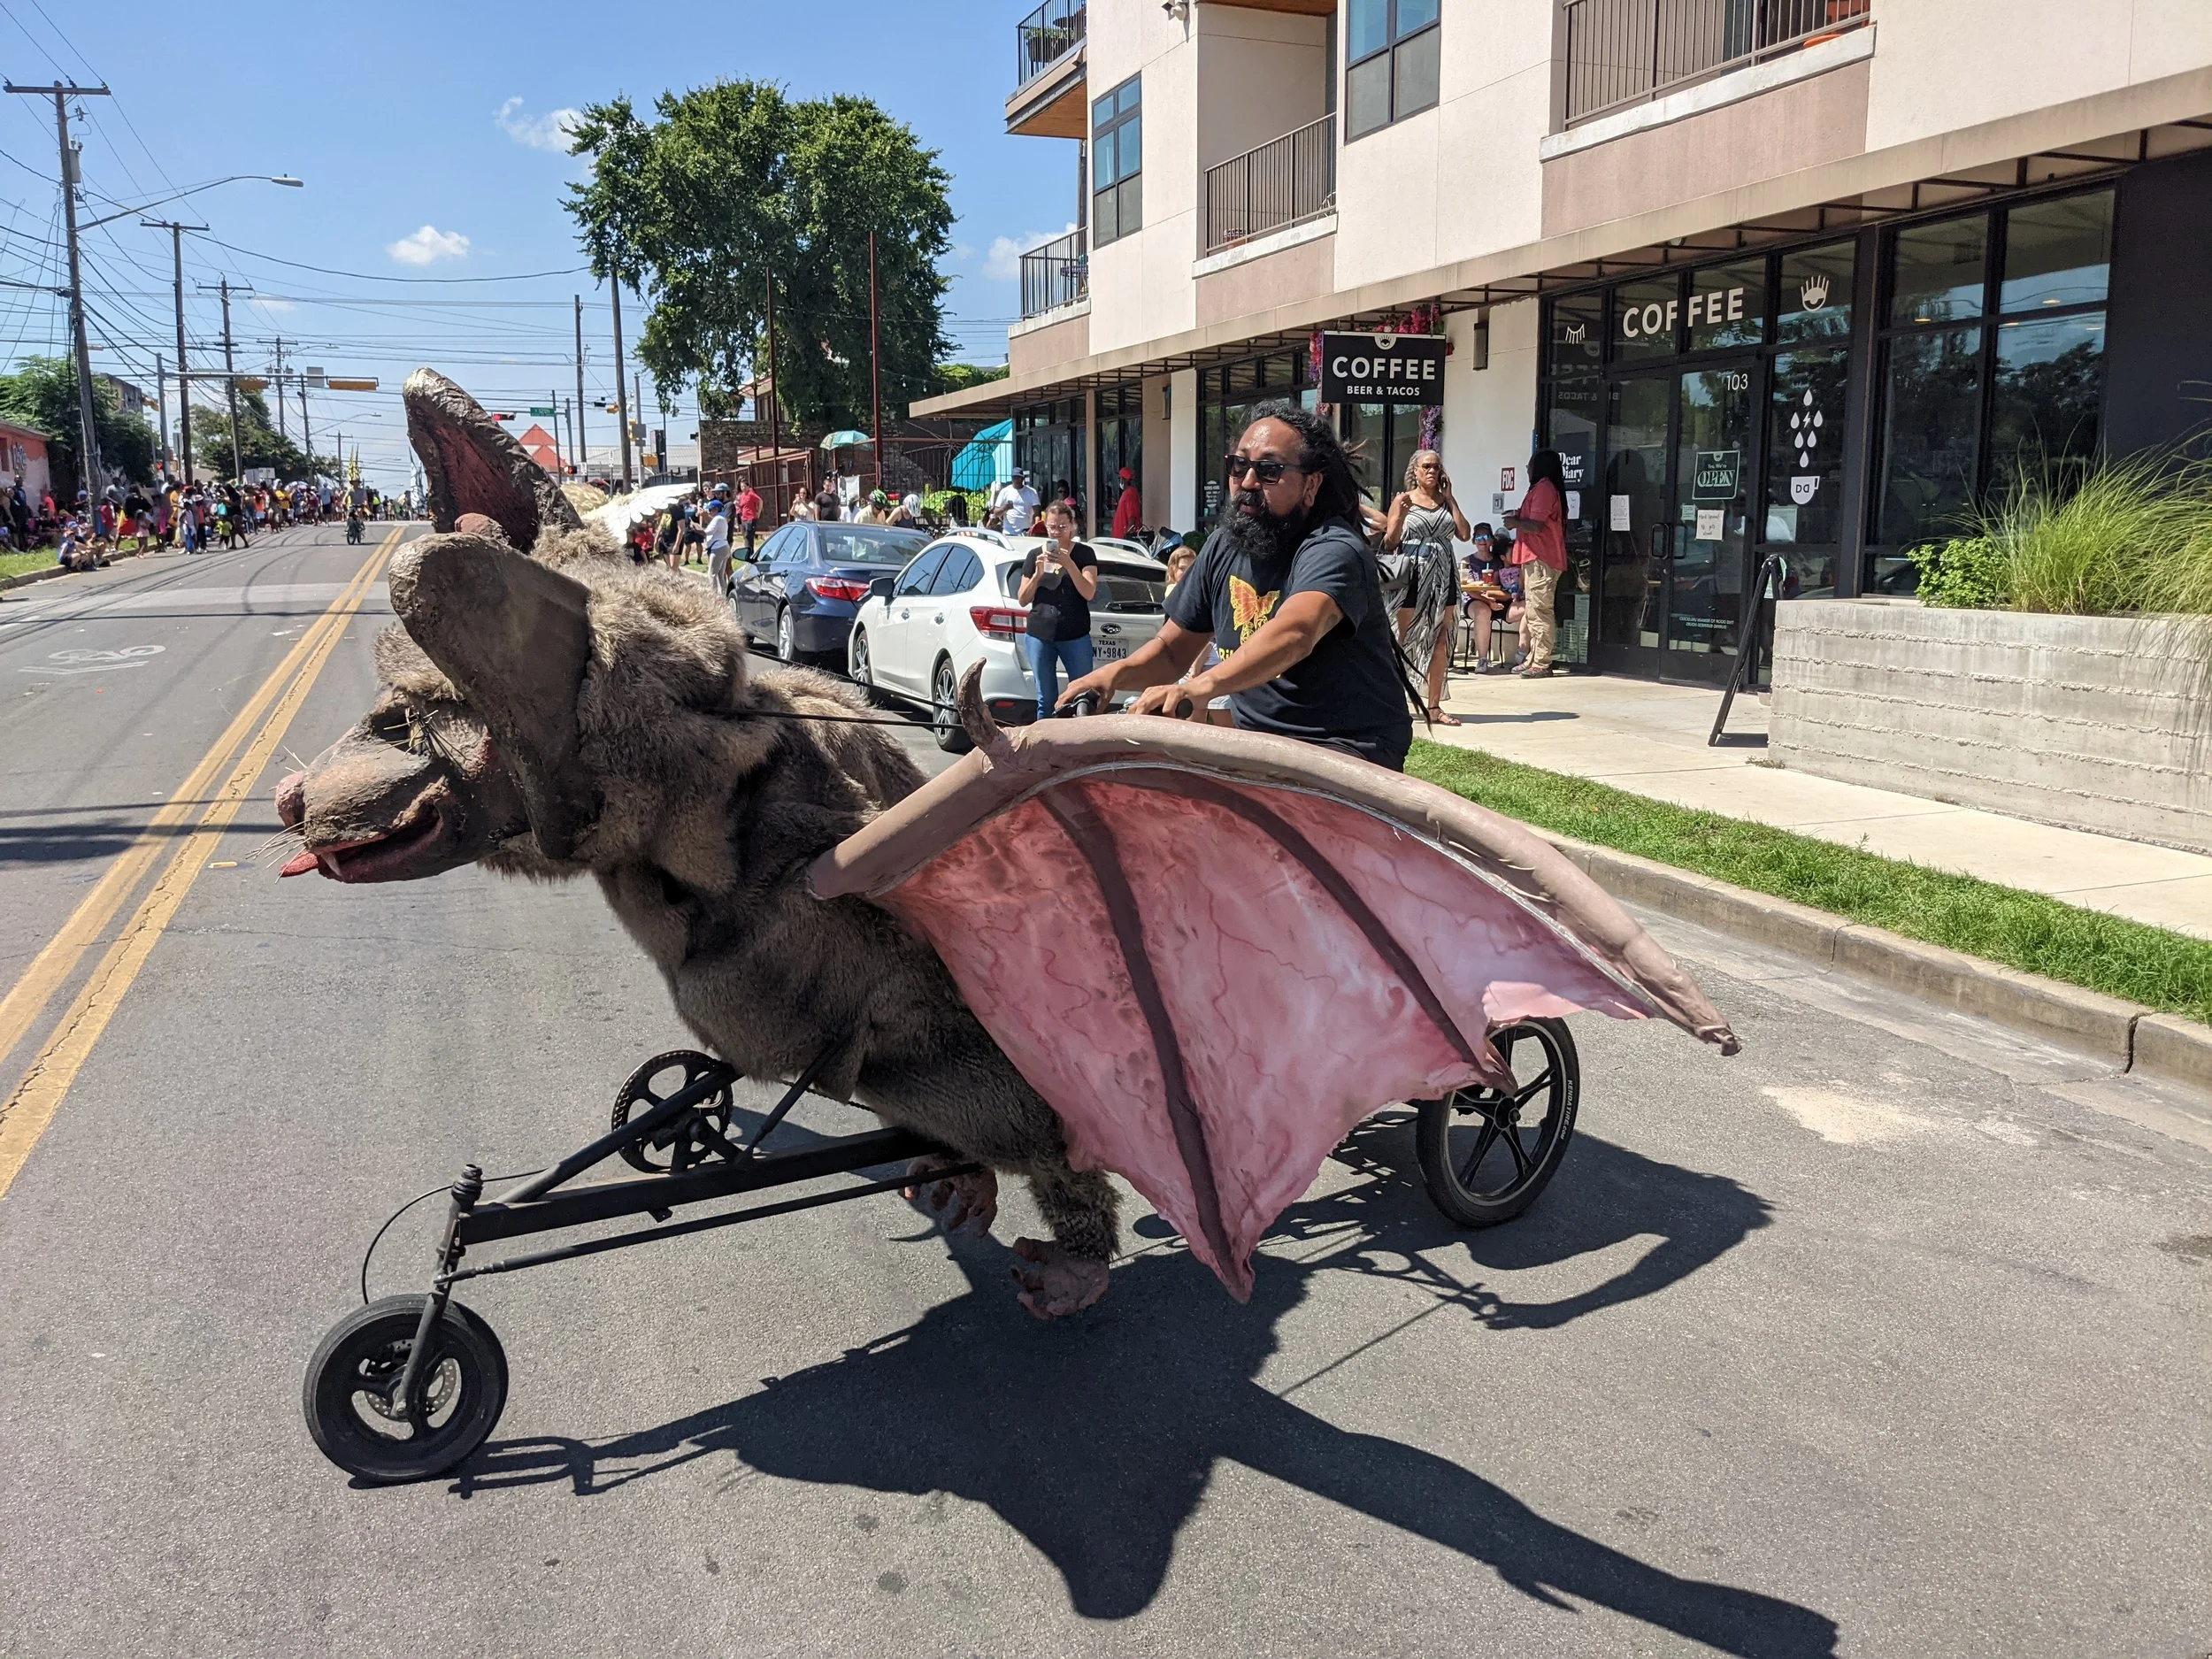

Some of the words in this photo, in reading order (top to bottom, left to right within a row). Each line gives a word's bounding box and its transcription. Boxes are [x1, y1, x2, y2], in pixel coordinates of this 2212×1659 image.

[1623, 288, 1743, 338] COFFEE
[1332, 356, 1436, 380] COFFEE
[1347, 385, 1372, 396] BEER
[1376, 386, 1384, 396] &
[1386, 387, 1420, 396] TACOS
[1726, 373, 1748, 390] 103
[1502, 469, 1514, 490] FDC
[1697, 469, 1735, 488] OPEN
